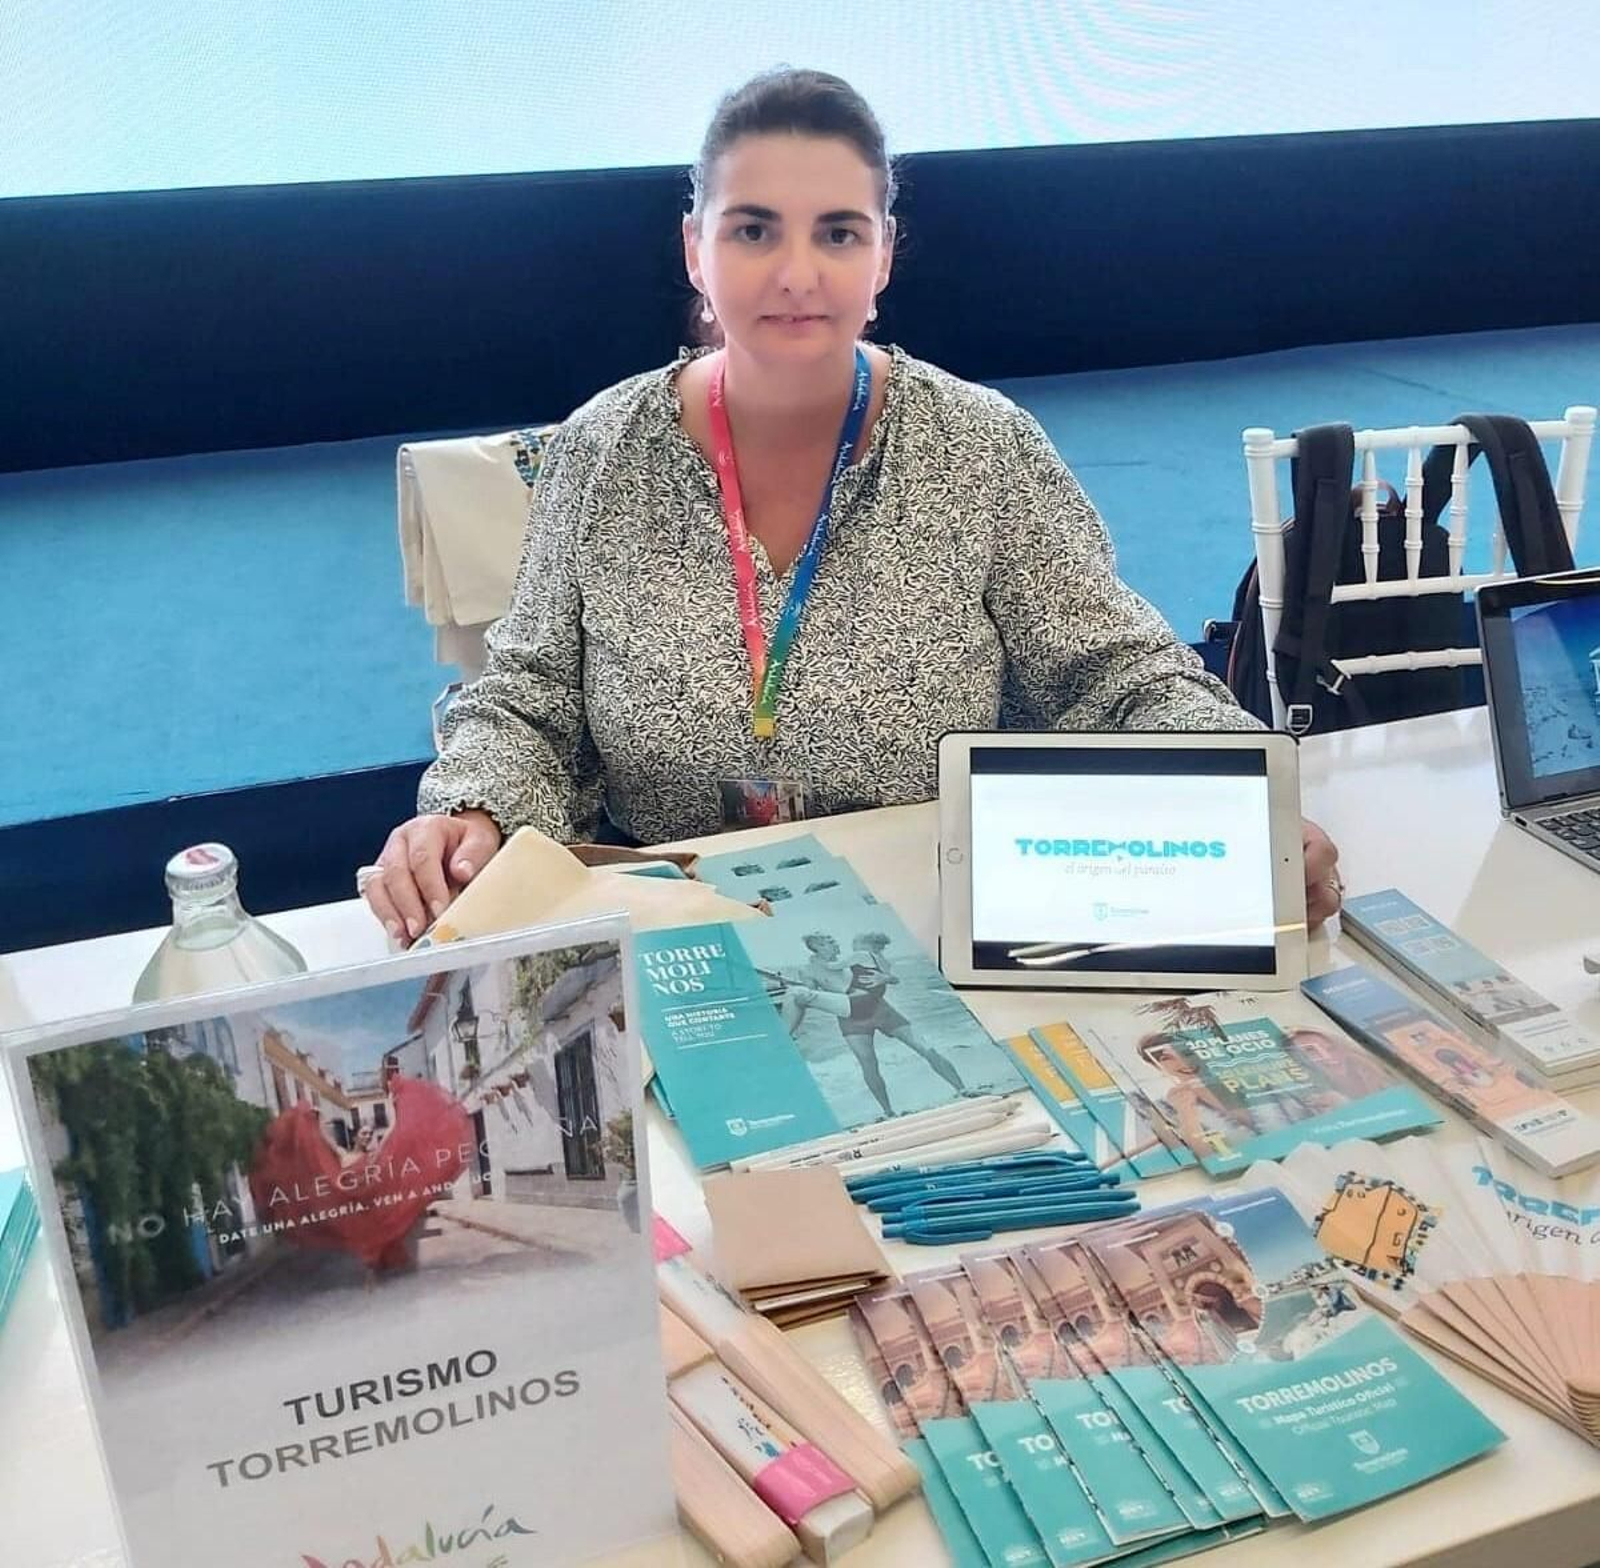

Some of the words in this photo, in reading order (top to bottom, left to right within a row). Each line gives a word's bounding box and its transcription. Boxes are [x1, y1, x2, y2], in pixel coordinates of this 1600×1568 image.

[1014, 838, 1227, 859] TORREMOLINOS
[638, 943, 726, 967] TORRE
[645, 960, 712, 982] MOLI
[652, 976, 705, 997] NOS
[1226, 1040, 1276, 1055] OCIO
[107, 1214, 166, 1245] NO
[268, 1156, 421, 1206] ALEGRÍA
[219, 1223, 259, 1245] DATE
[263, 1217, 296, 1234] UNA
[373, 1192, 402, 1208] VEN
[407, 1190, 417, 1199] A
[1505, 1210, 1582, 1246] rigen
[283, 1349, 498, 1426] TURISMO
[1236, 1356, 1398, 1414] TORREMOLINOS
[206, 1369, 581, 1488] TORREMOLINOS
